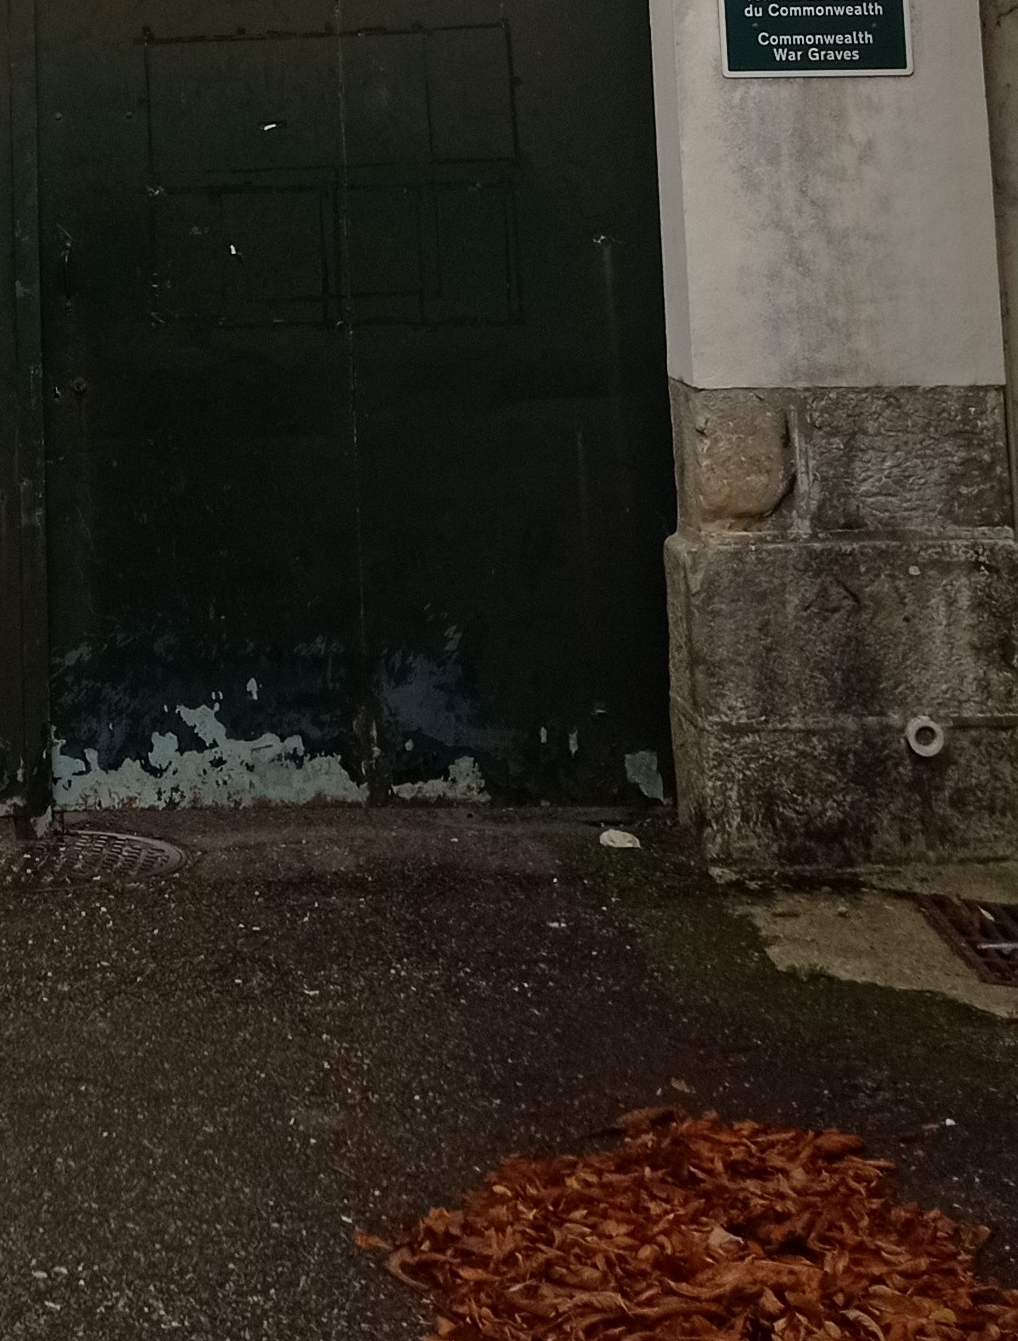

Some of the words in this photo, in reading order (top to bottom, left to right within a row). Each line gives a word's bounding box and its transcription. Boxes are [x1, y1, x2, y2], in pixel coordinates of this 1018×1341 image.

[744, 4, 763, 18] du
[767, 2, 884, 18] Commonwealth
[757, 30, 874, 46] Commonwealth
[773, 48, 803, 62] War
[807, 47, 860, 61] Graves
